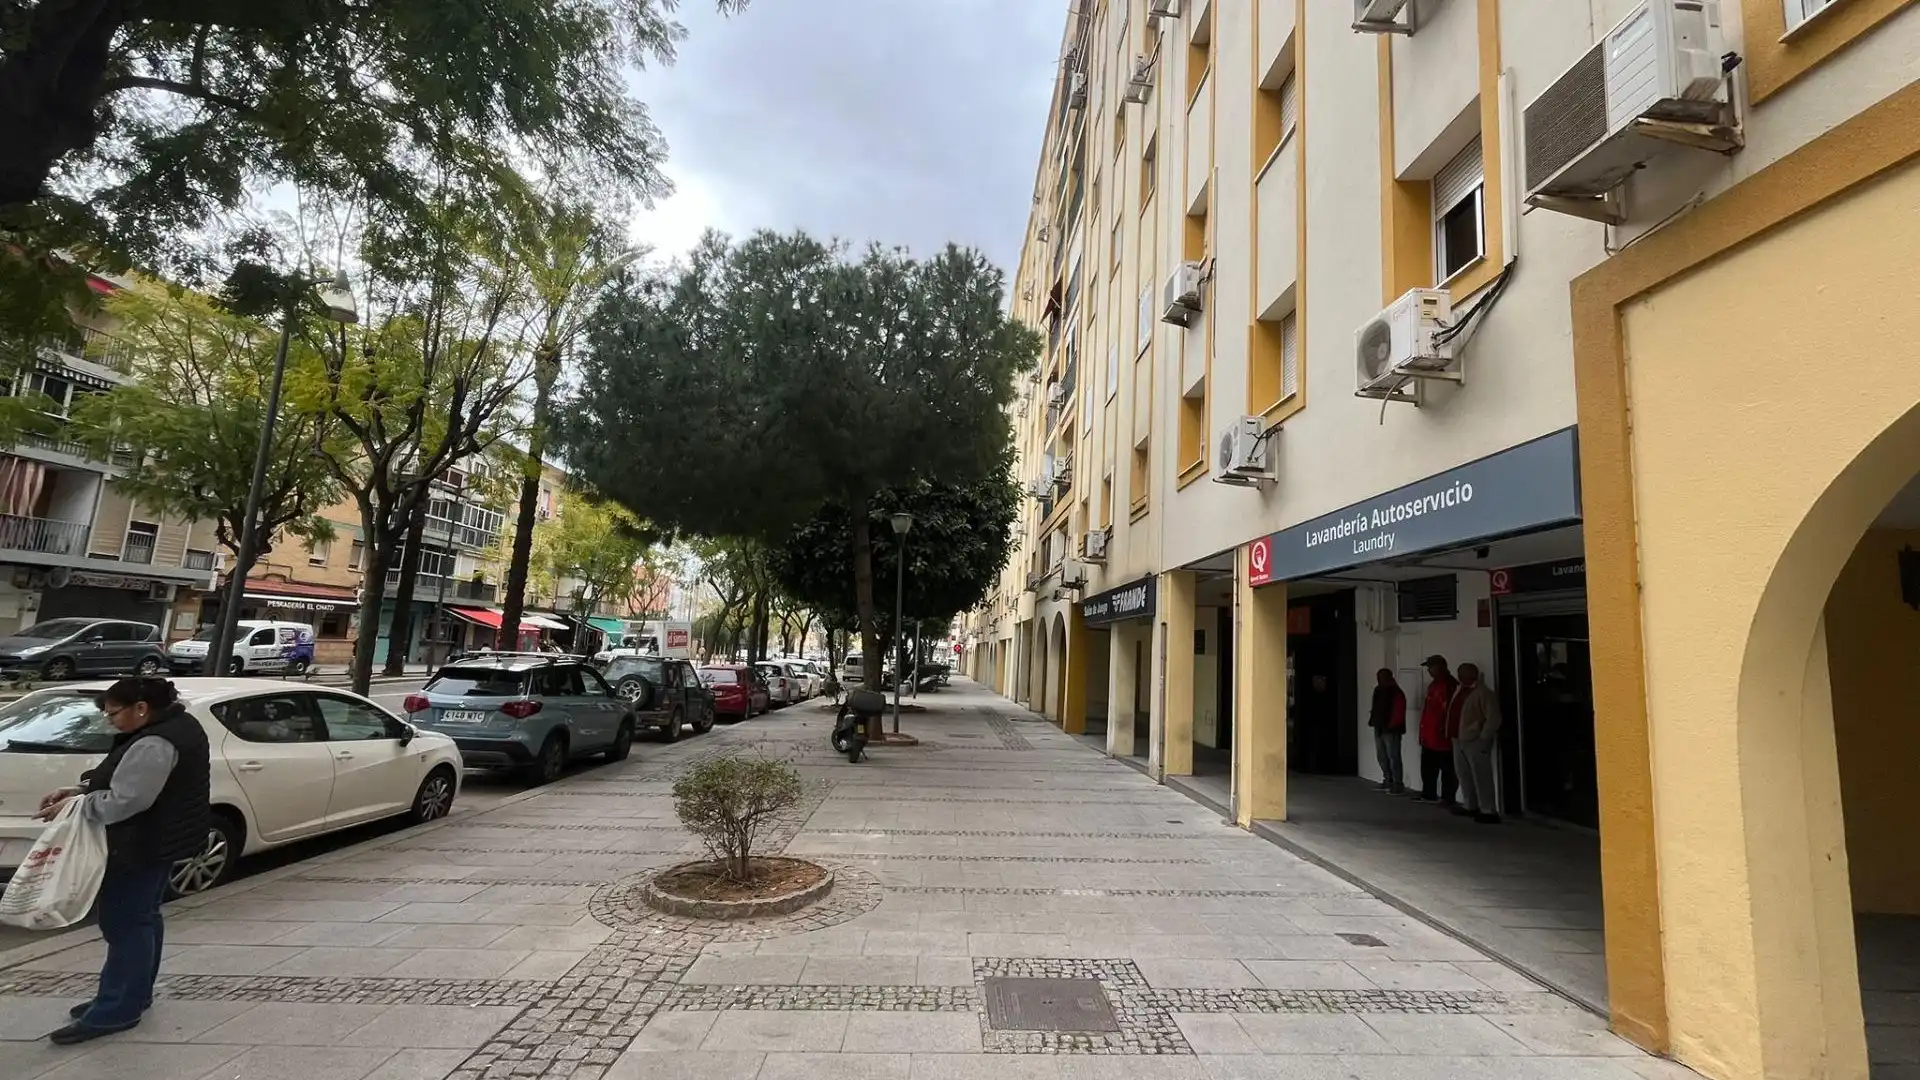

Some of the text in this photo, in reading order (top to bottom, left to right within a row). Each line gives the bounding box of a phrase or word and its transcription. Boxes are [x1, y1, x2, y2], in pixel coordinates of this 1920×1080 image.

[1306, 480, 1473, 548] Lavandería Autoservicio
[1353, 532, 1395, 555] Laundry
[306, 602, 315, 611] EL
